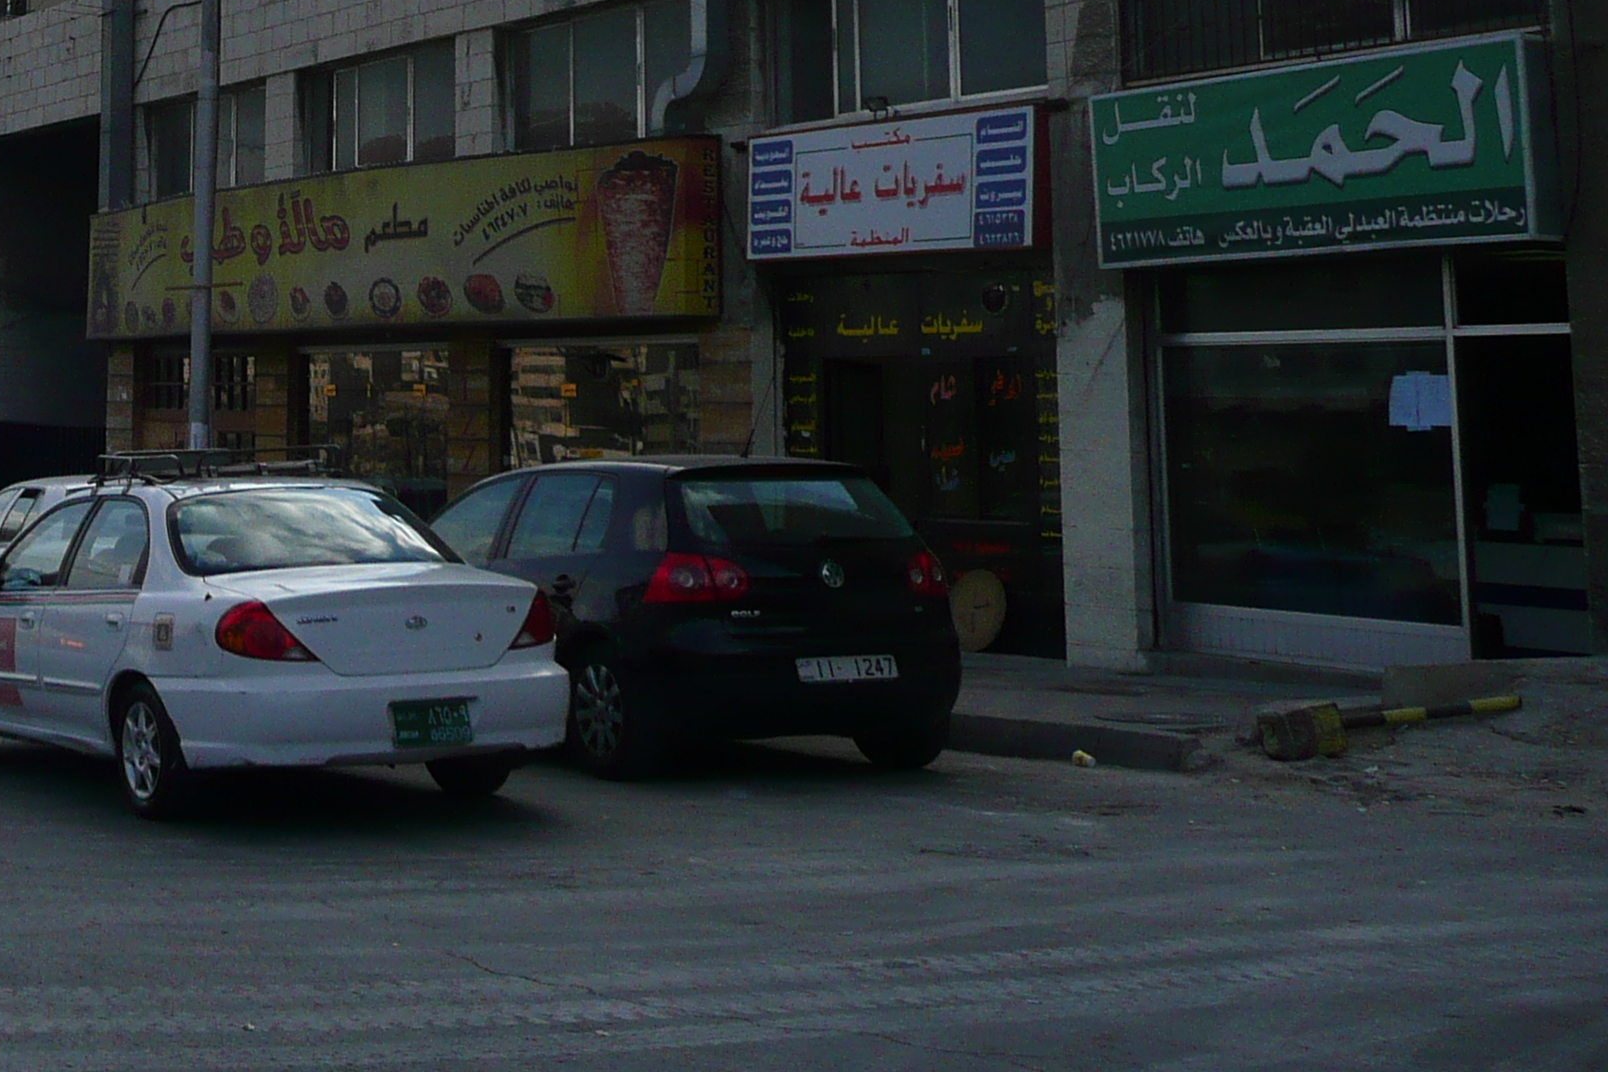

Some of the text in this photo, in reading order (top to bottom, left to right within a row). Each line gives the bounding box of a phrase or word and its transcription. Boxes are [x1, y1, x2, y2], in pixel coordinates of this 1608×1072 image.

[1102, 92, 1197, 146] لنقل
[851, 127, 911, 153] مكتب
[800, 160, 966, 216] سفريات عالية
[1107, 156, 1202, 209] الركاب
[365, 201, 428, 254] مطعم
[1336, 209, 1397, 243] العبدلي
[1398, 203, 1466, 228] منتظمة
[1469, 198, 1527, 227] رحلات
[1168, 226, 1205, 247] هاتف
[1284, 215, 1334, 245] العقبة
[838, 310, 984, 344] سفريات عالية
[730, 609, 761, 619] GOLF
